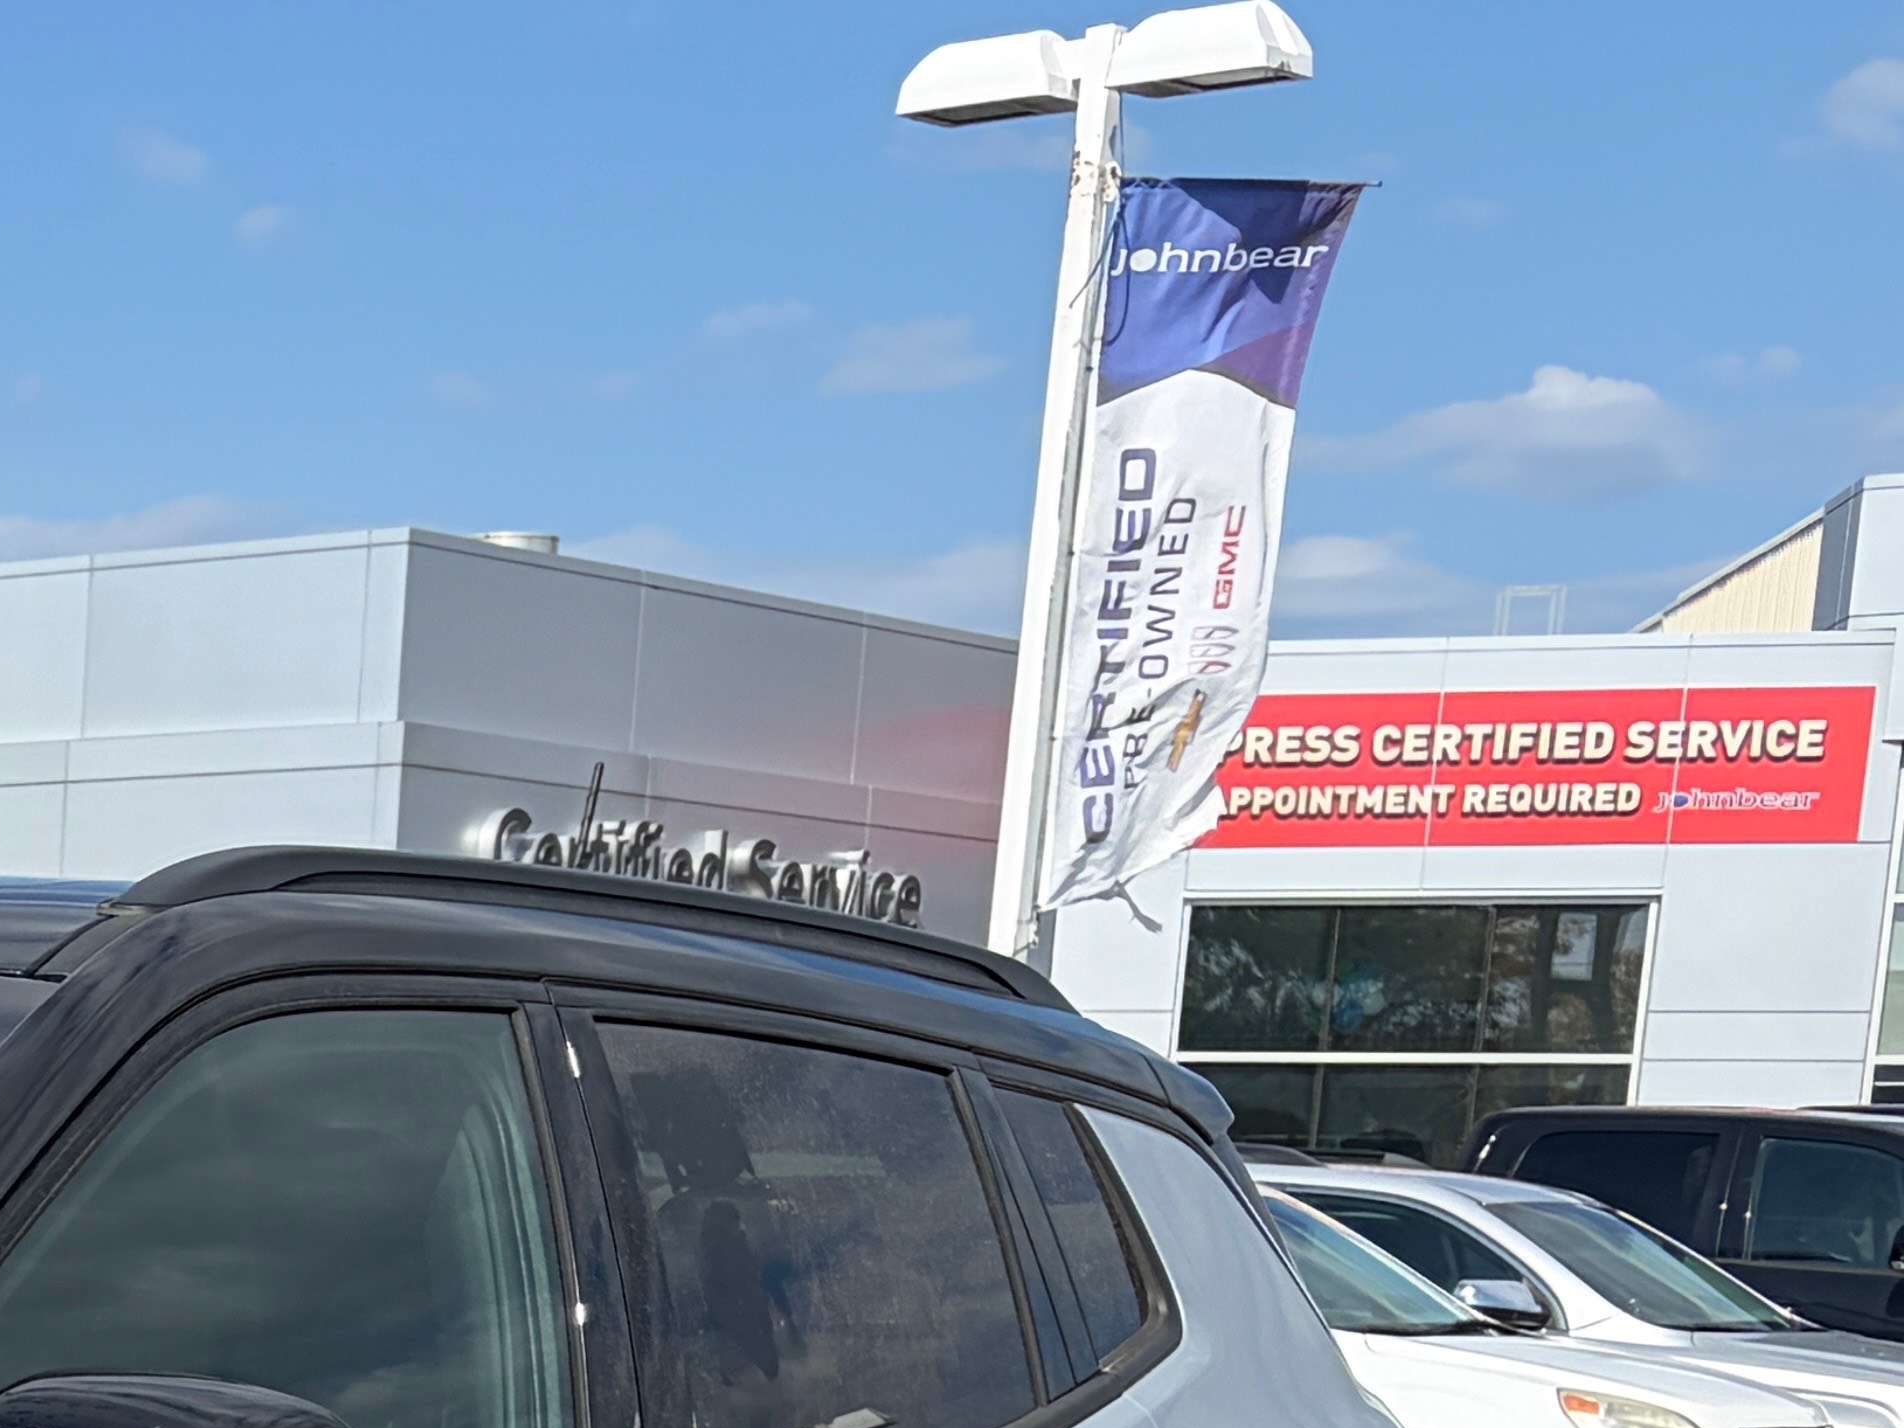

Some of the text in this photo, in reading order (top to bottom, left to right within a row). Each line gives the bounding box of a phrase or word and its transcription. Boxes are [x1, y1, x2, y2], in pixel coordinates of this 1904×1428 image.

[1213, 504, 1247, 610] GMC
[1079, 447, 1157, 845] CERTIFIED
[1371, 720, 1616, 764] CERTIFIED
[1623, 719, 1828, 761] SERVICE
[1463, 782, 1642, 815] REQUIRED
